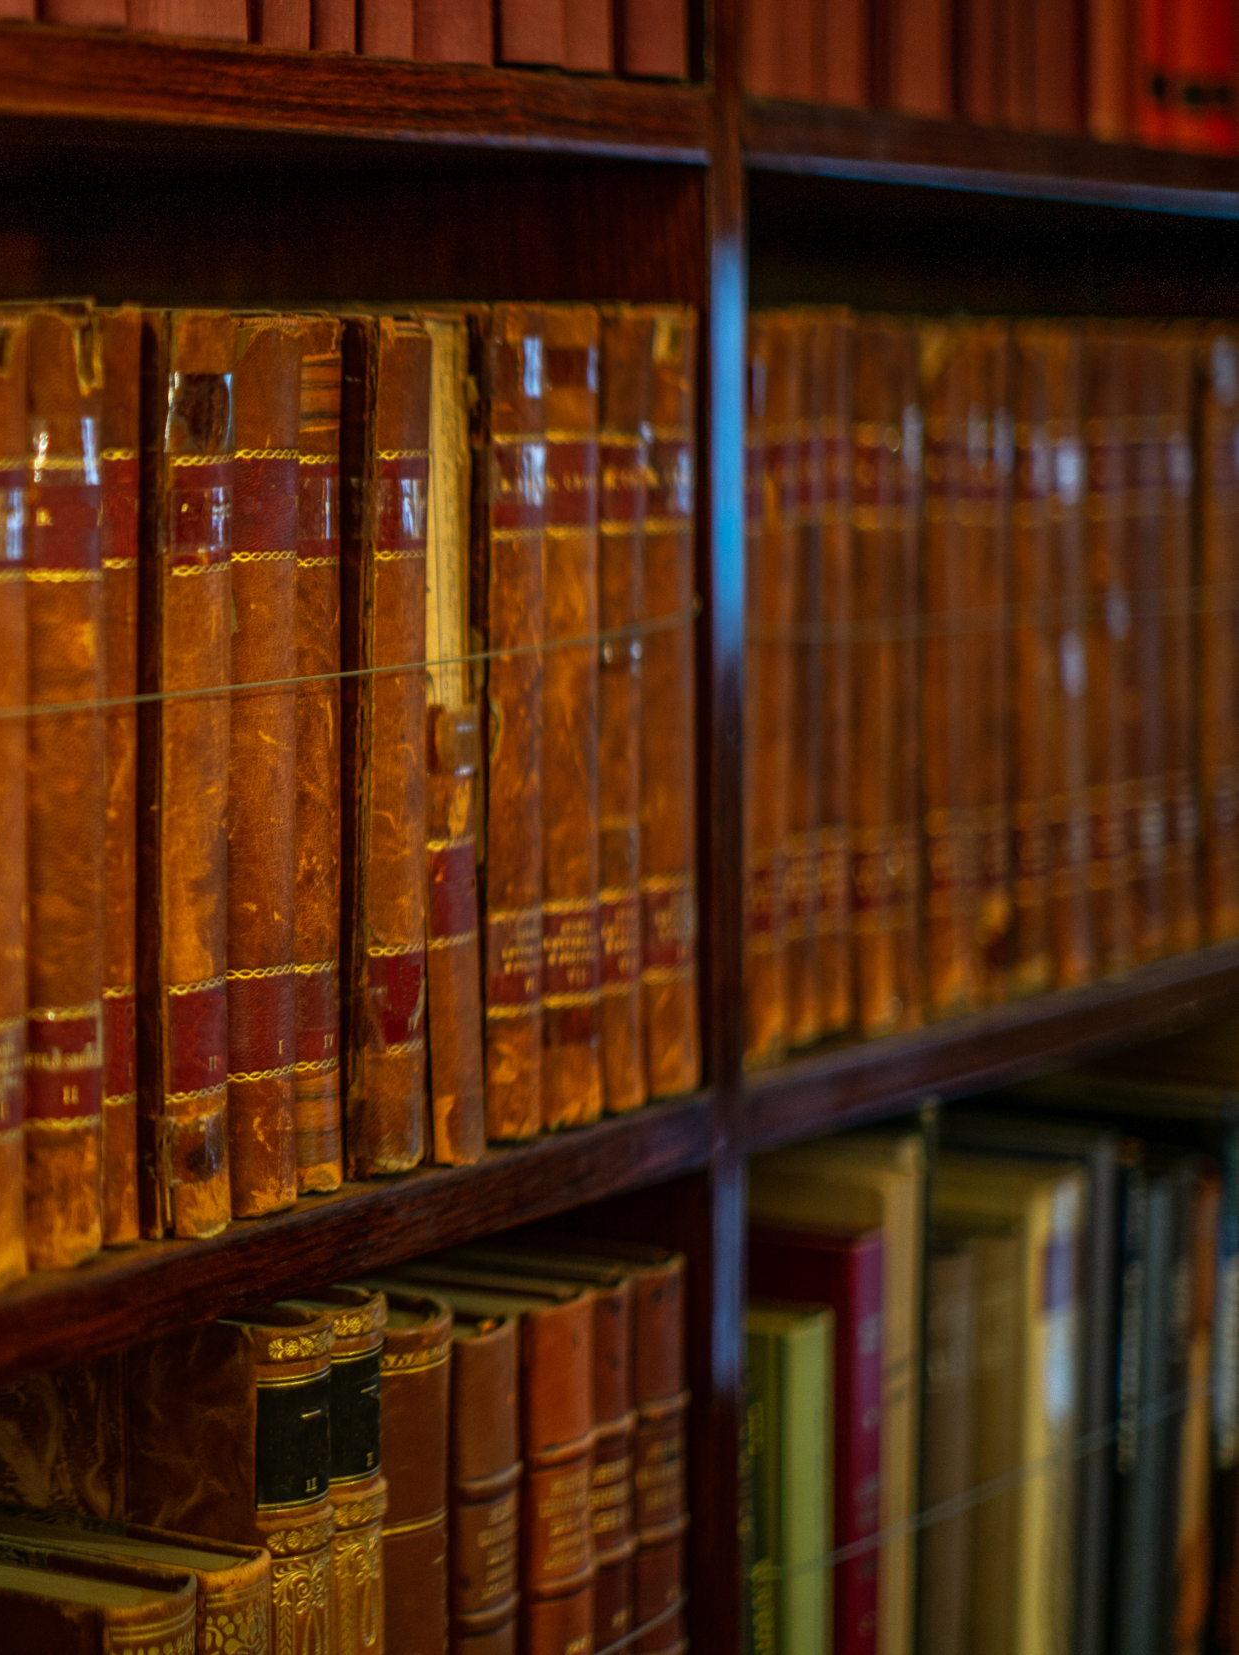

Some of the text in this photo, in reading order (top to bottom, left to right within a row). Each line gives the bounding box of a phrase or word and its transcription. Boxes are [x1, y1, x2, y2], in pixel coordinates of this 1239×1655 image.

[278, 1039, 284, 1055] I
[323, 1033, 334, 1049] IV
[209, 1055, 218, 1072] II
[62, 1085, 79, 1105] II
[366, 1451, 374, 1467] I
[305, 1476, 317, 1492] II
